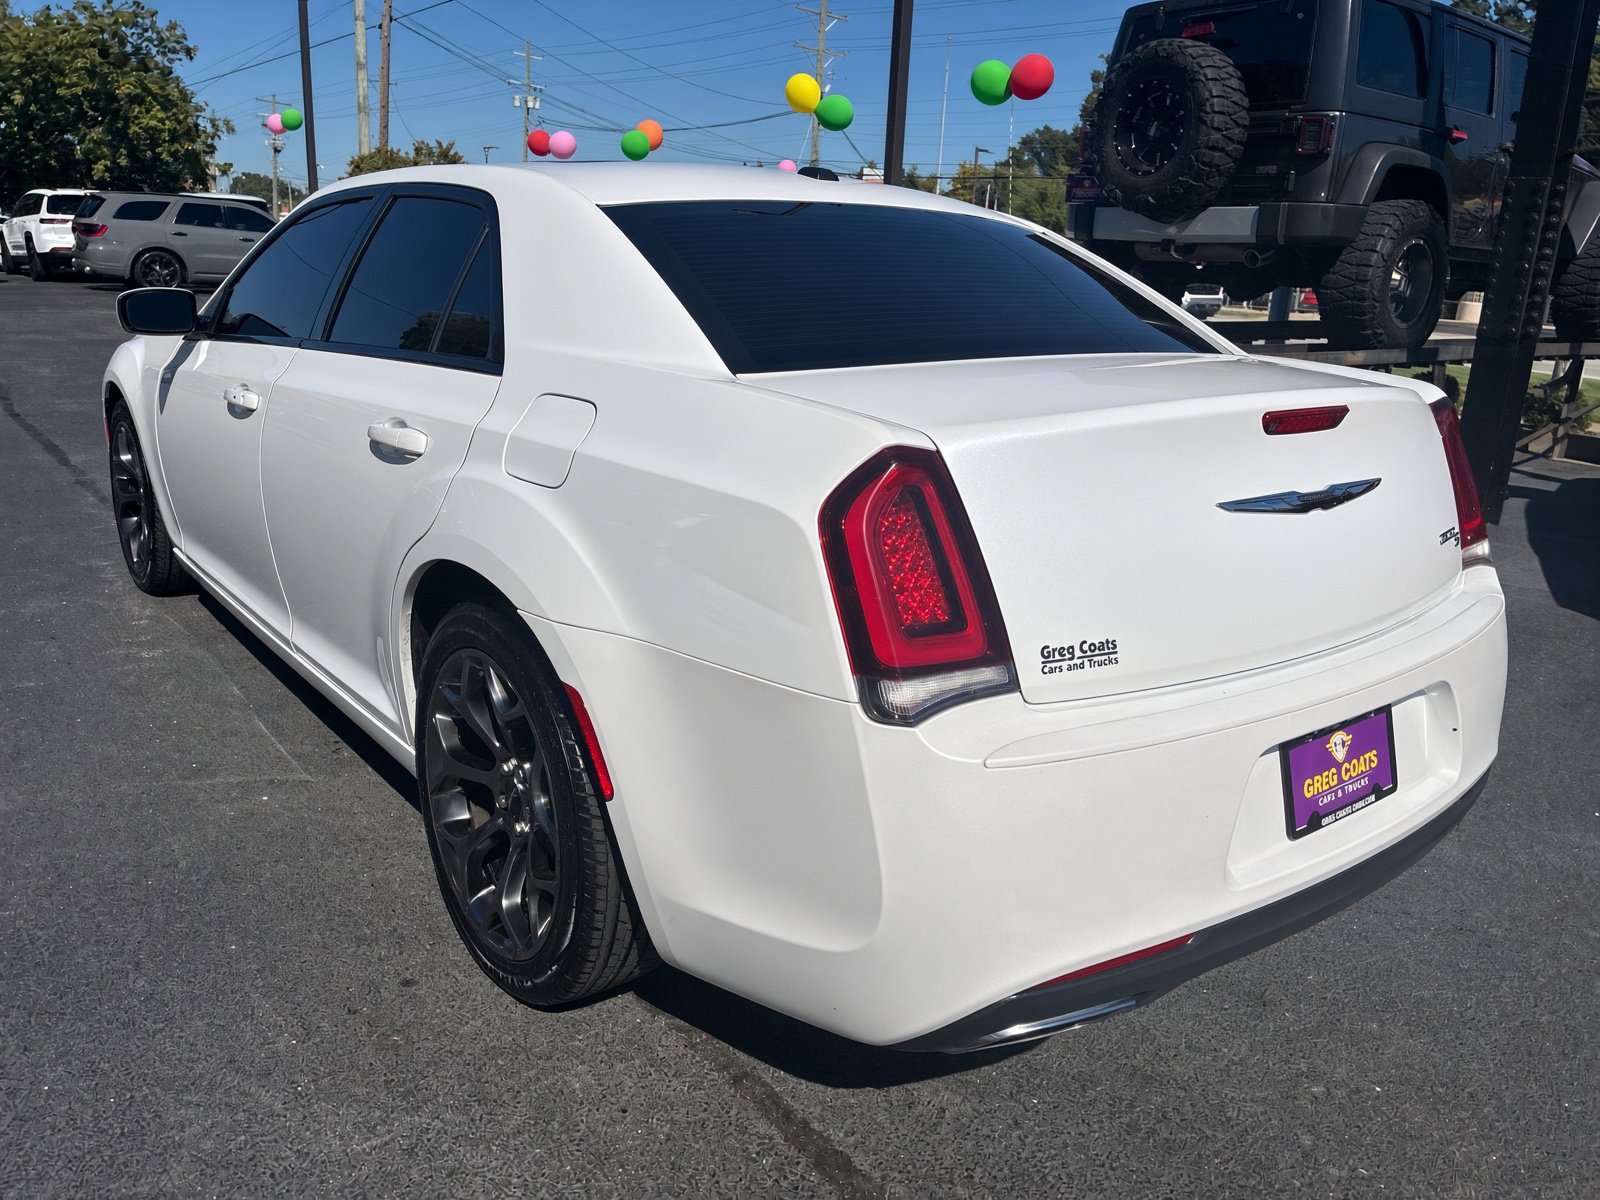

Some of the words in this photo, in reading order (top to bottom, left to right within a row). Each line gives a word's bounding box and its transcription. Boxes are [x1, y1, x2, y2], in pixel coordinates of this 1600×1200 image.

[1041, 645, 1075, 661] Greg
[1079, 638, 1117, 654] Coats
[1041, 665, 1063, 675] Cars
[1066, 660, 1085, 672] and
[1087, 656, 1118, 668] Trucks
[1303, 767, 1338, 798] GREG
[1341, 749, 1378, 781] COATS
